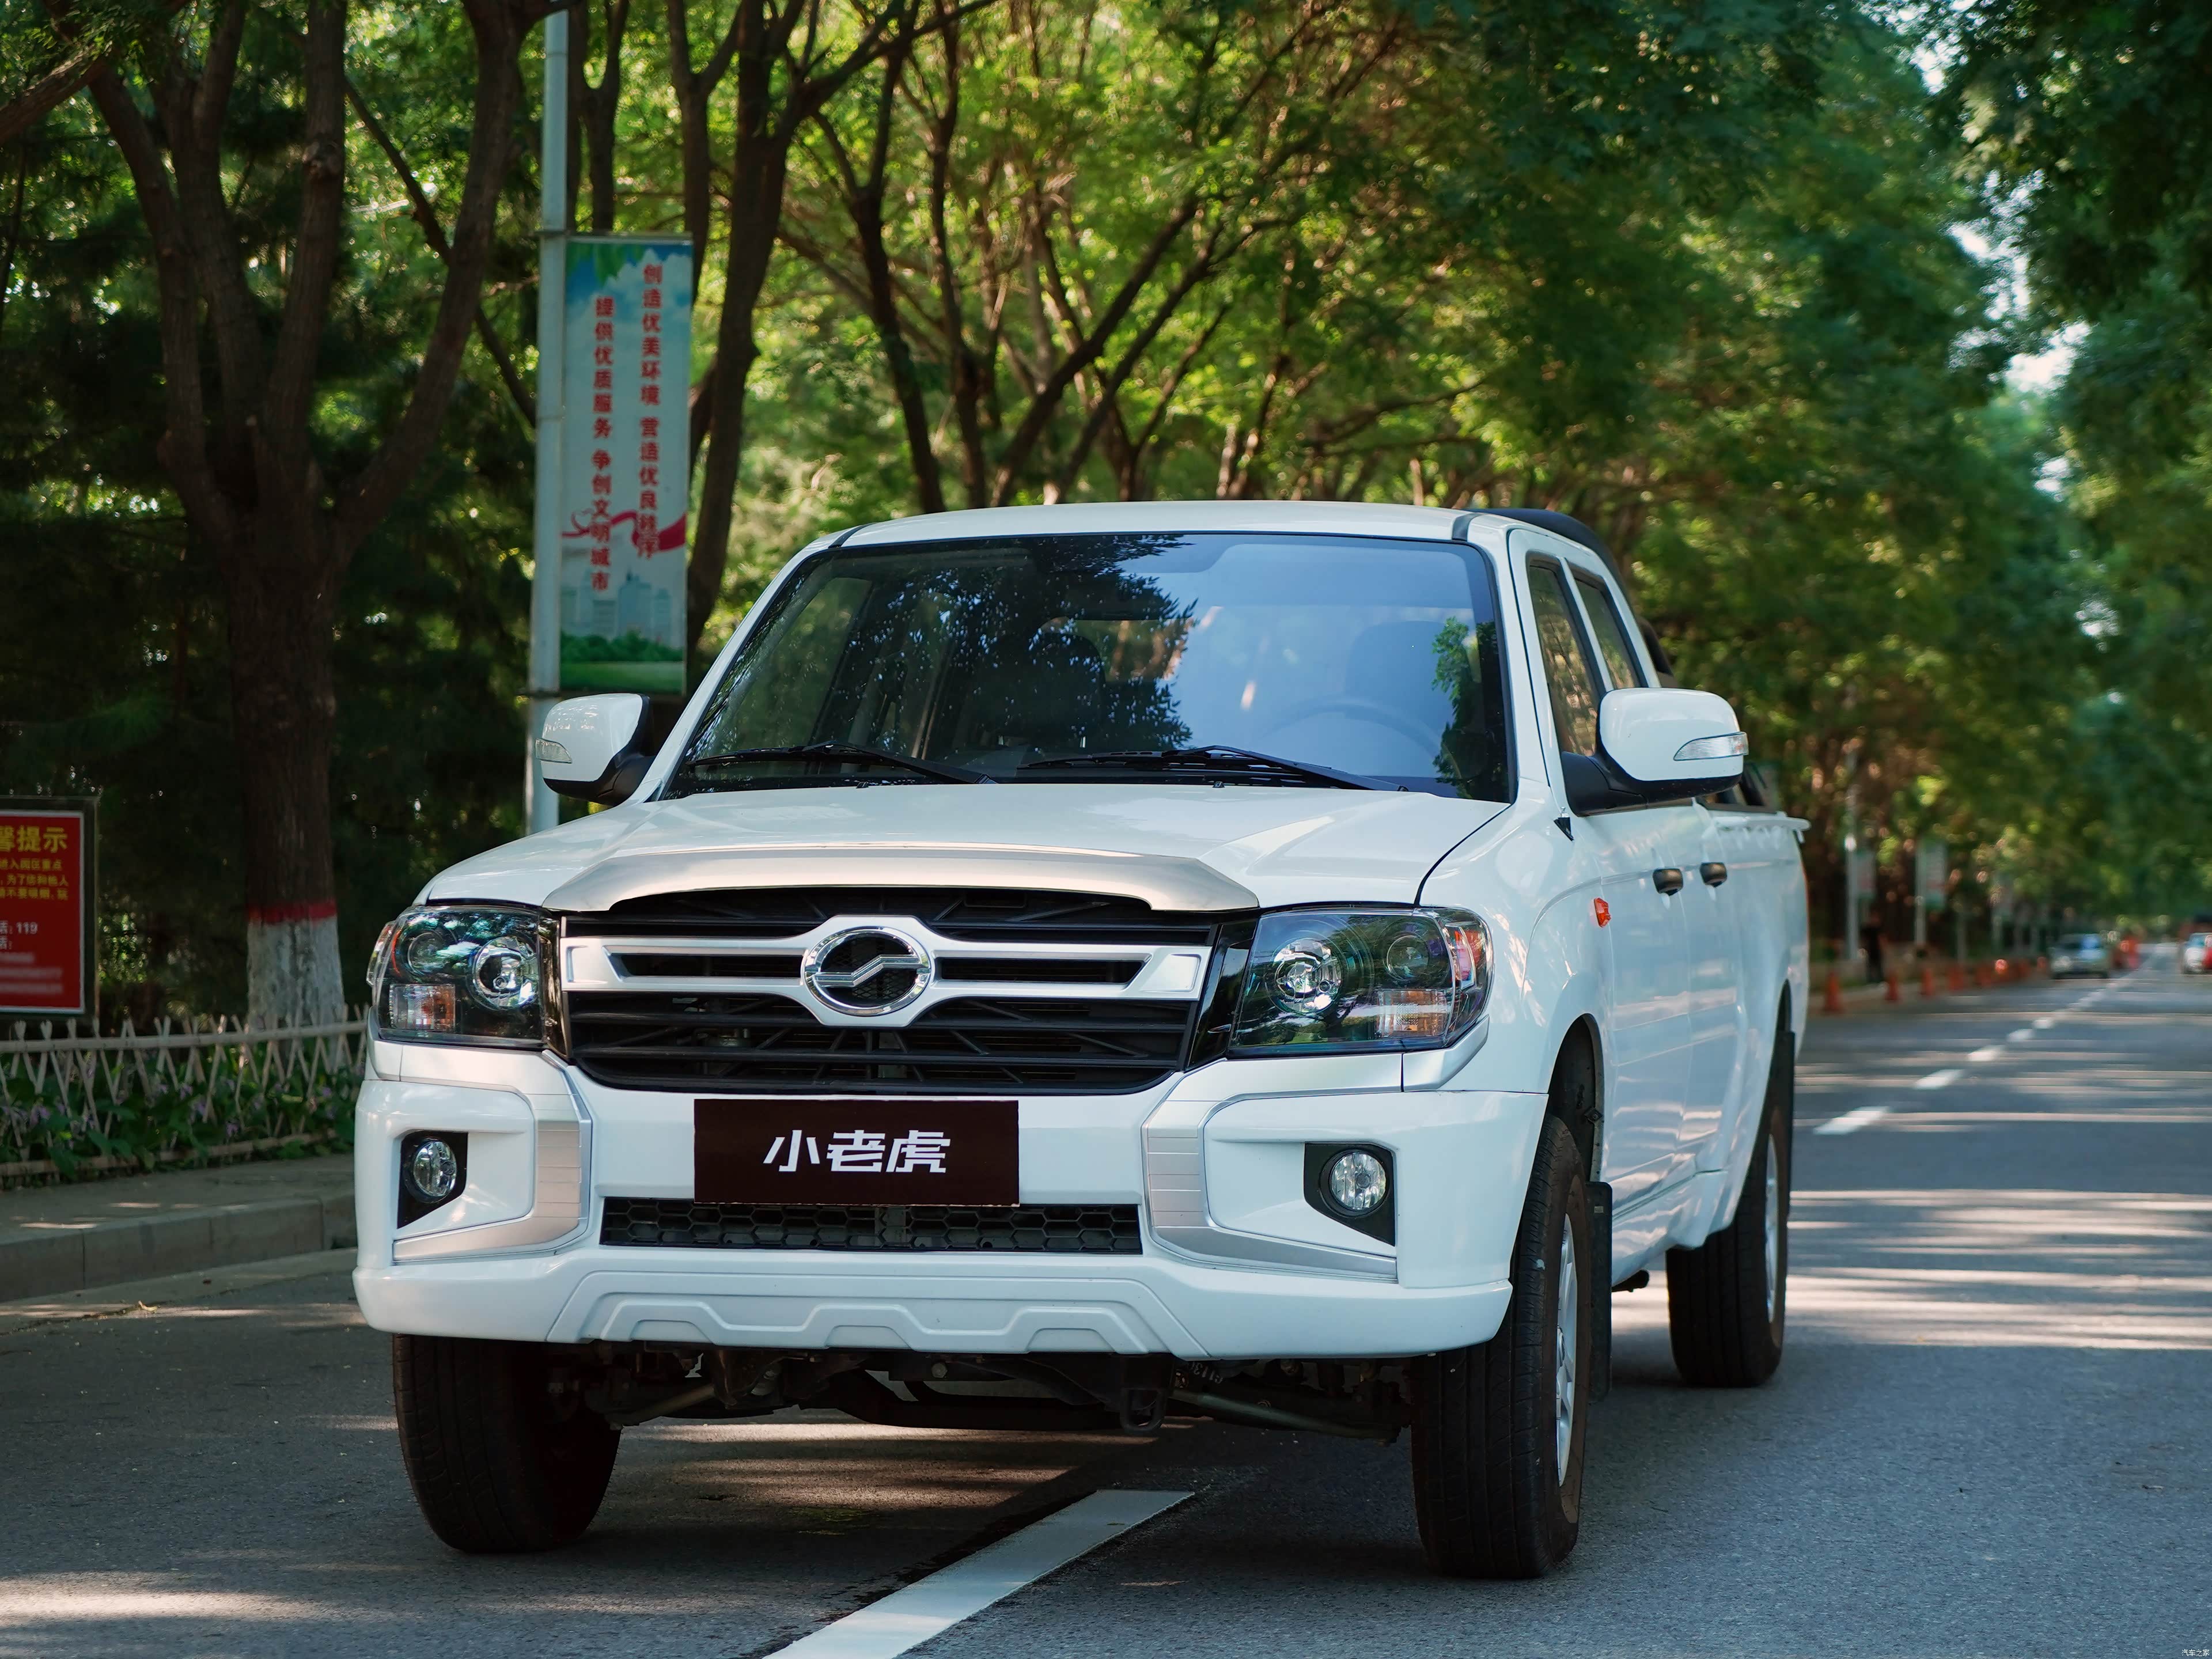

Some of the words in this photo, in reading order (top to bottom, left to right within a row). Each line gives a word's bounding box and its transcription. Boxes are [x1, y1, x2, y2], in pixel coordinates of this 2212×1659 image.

[593, 296, 615, 438] 提供优质服务
[640, 264, 662, 405] 创造优美环境
[590, 449, 612, 590] 争创文明城市
[0, 825, 68, 853] 馨提示
[763, 1130, 950, 1173] 小老虎
